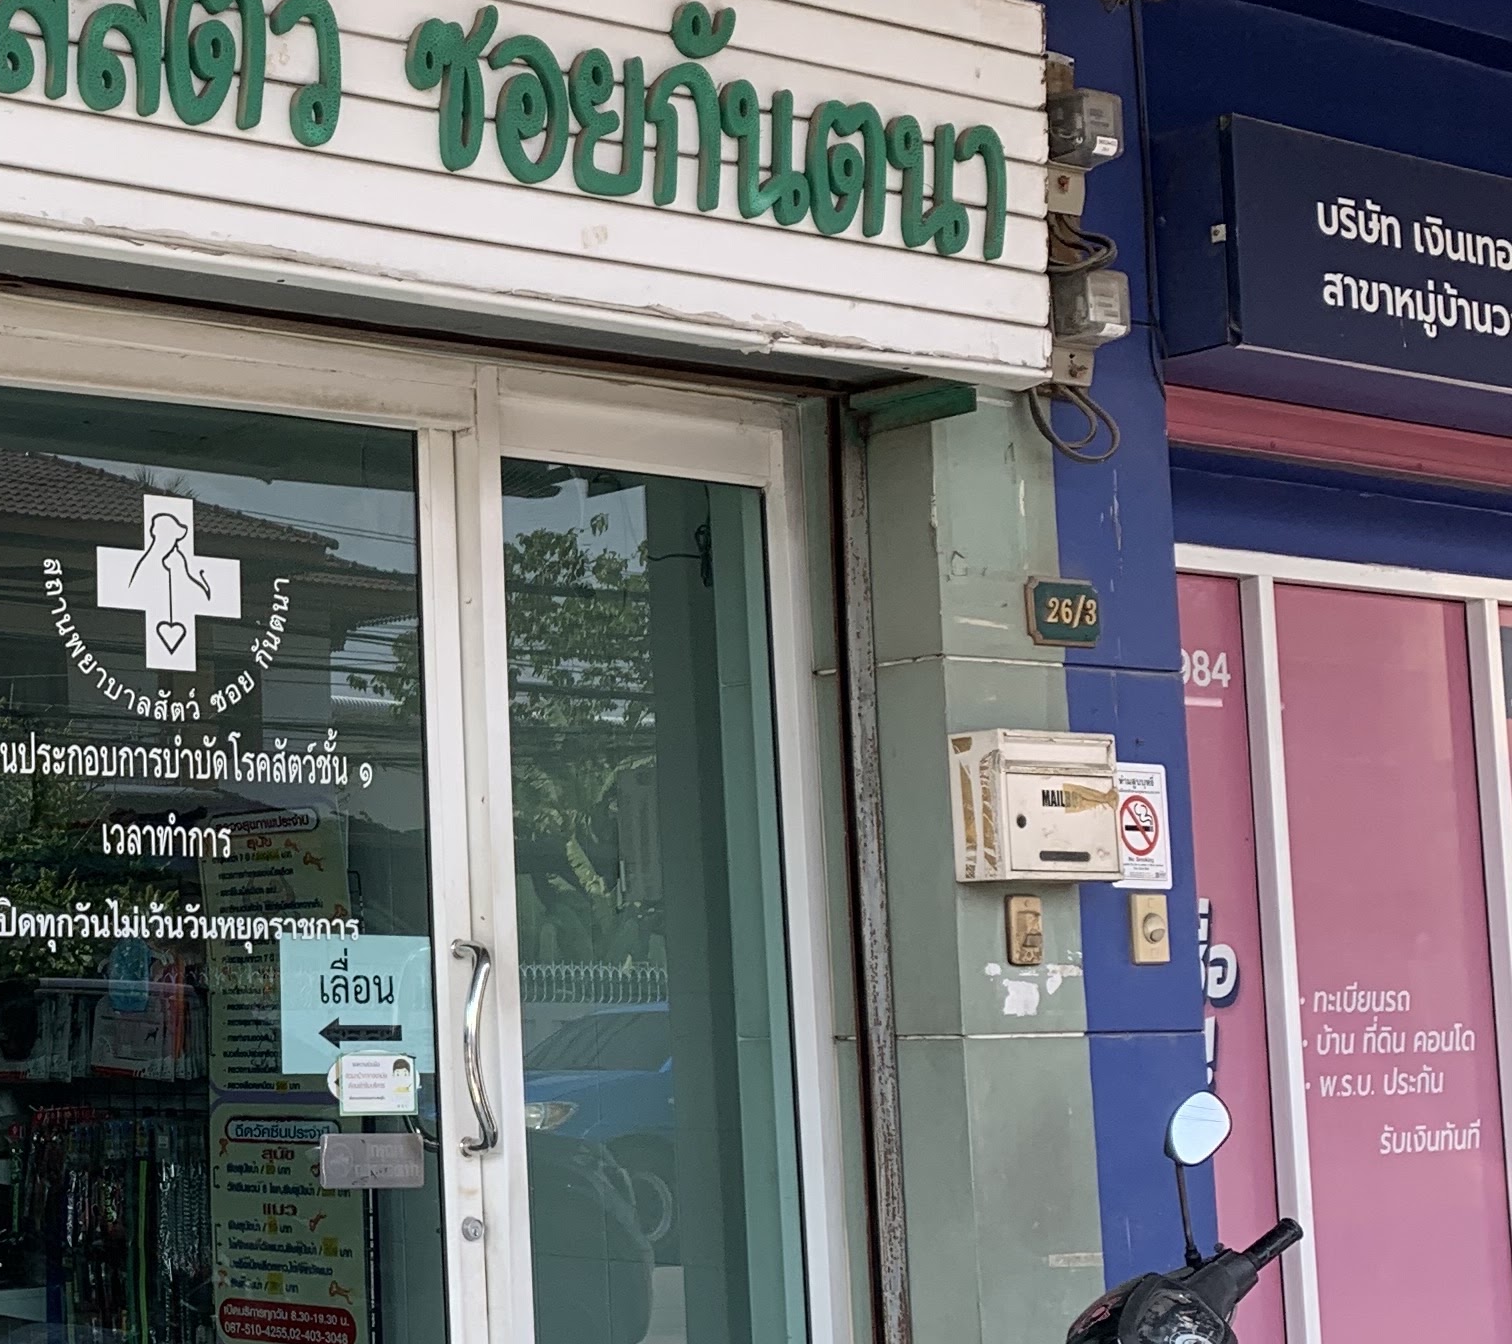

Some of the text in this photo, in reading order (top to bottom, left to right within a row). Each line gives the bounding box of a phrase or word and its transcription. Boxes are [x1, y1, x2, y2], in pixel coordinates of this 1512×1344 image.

[406, 1, 1006, 259] ซอยกันตนา
[1316, 197, 1402, 249] บริษัท
[1323, 272, 1512, 338] สาขาหมู่บ้านว
[1045, 595, 1097, 629] 26/3
[43, 558, 290, 722] สถานพยาบาลสัตว์ ซอย กันตนา
[359, 762, 373, 788] ๑
[102, 812, 231, 858] เวลาทำการ
[319, 948, 395, 1005] เลื่อน
[1313, 981, 1411, 1013] ทะเบียนรถ
[1317, 1016, 1475, 1055] บ้าน ที่ดิน คอนโด
[1319, 1064, 1444, 1097] พ.ร.บ. ประกัน
[1380, 1119, 1481, 1154] รับเงินทันที
[263, 1203, 298, 1216] แมว
